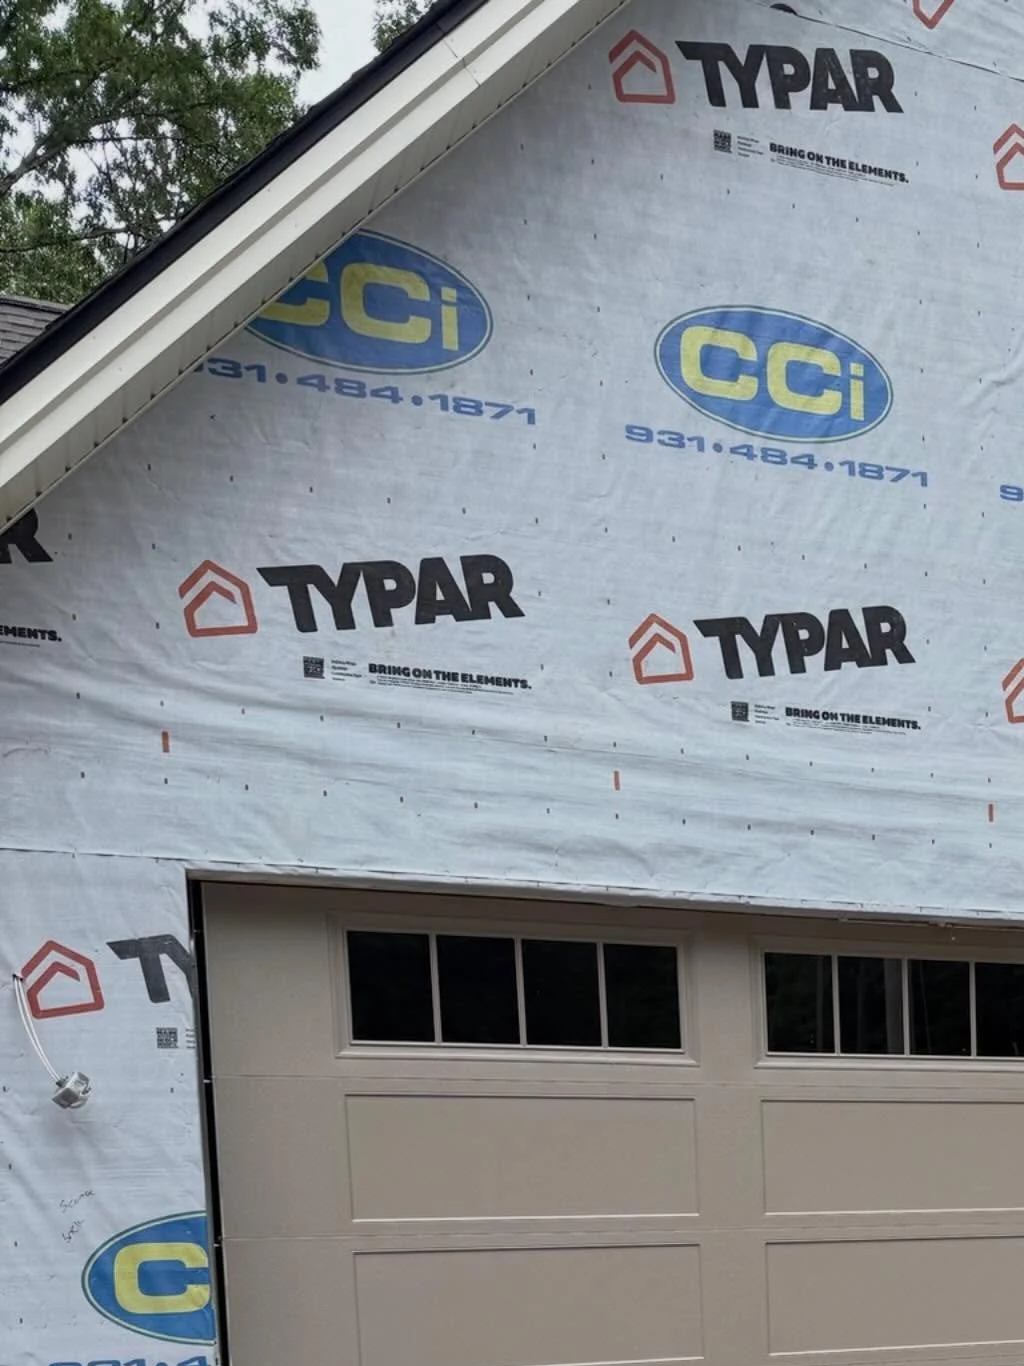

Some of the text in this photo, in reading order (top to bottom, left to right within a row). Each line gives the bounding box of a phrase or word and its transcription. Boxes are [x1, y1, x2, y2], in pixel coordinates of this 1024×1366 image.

[675, 40, 904, 114] TYPAR
[769, 142, 805, 159] BRING
[807, 150, 824, 164] ON
[825, 155, 847, 169] THE
[848, 161, 909, 183] ELEMENTS.
[680, 325, 866, 421] CCi
[256, 553, 525, 633] TYPAR
[368, 662, 411, 679] BRING
[412, 667, 432, 680] ON
[433, 669, 459, 683] THE
[461, 672, 532, 690] ELEMENTS.
[693, 605, 916, 680] TYPAR
[785, 706, 820, 720] BRING
[821, 711, 838, 721] ON
[839, 713, 861, 724] THE
[862, 715, 921, 730] ELEMENTS.
